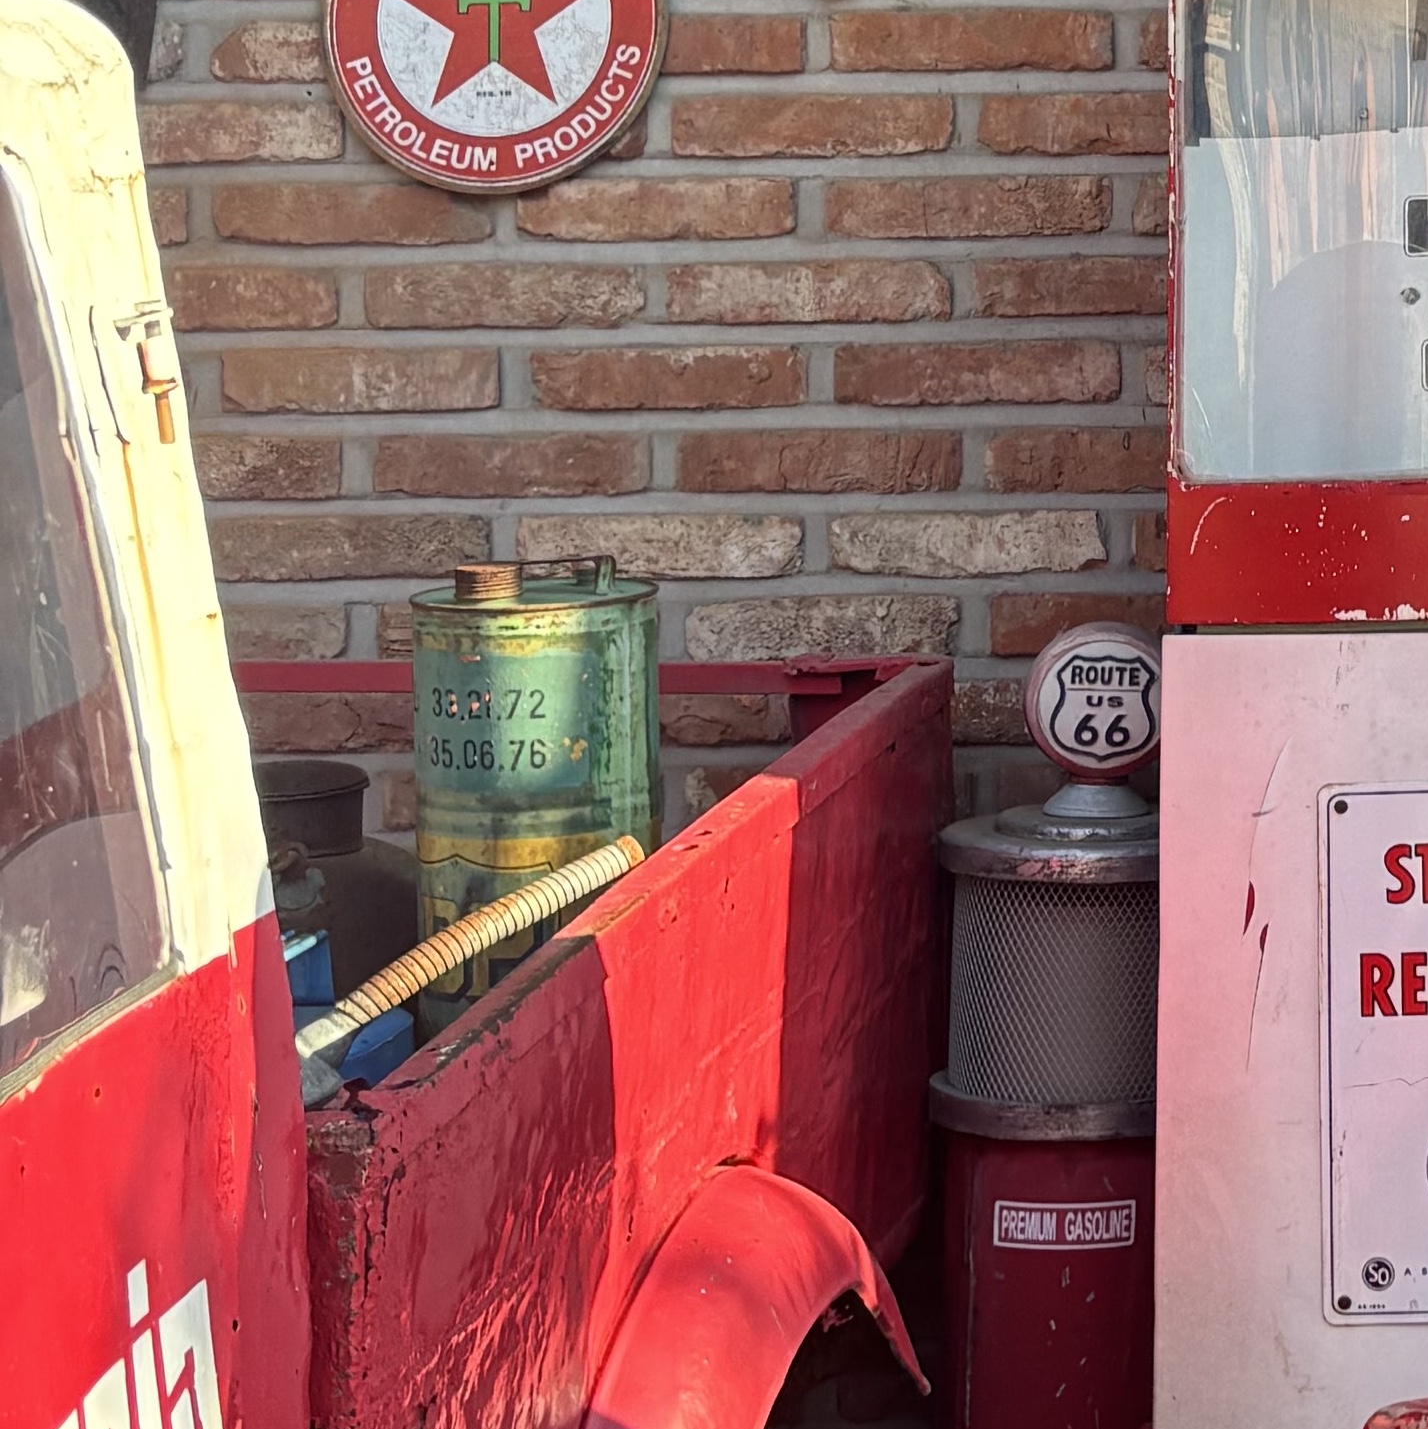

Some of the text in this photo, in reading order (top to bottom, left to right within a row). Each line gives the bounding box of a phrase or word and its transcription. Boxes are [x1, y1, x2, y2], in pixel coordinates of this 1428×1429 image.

[346, 44, 641, 171] PETROLEUM PRODUCTS
[1070, 665, 1141, 687] ROUTE
[1086, 695, 1124, 708] US
[1074, 713, 1131, 748] 66
[430, 738, 547, 771] 35.06.76
[1001, 1208, 1131, 1241] PREMIUM GASOLINE
[1404, 1268, 1412, 1276] A
